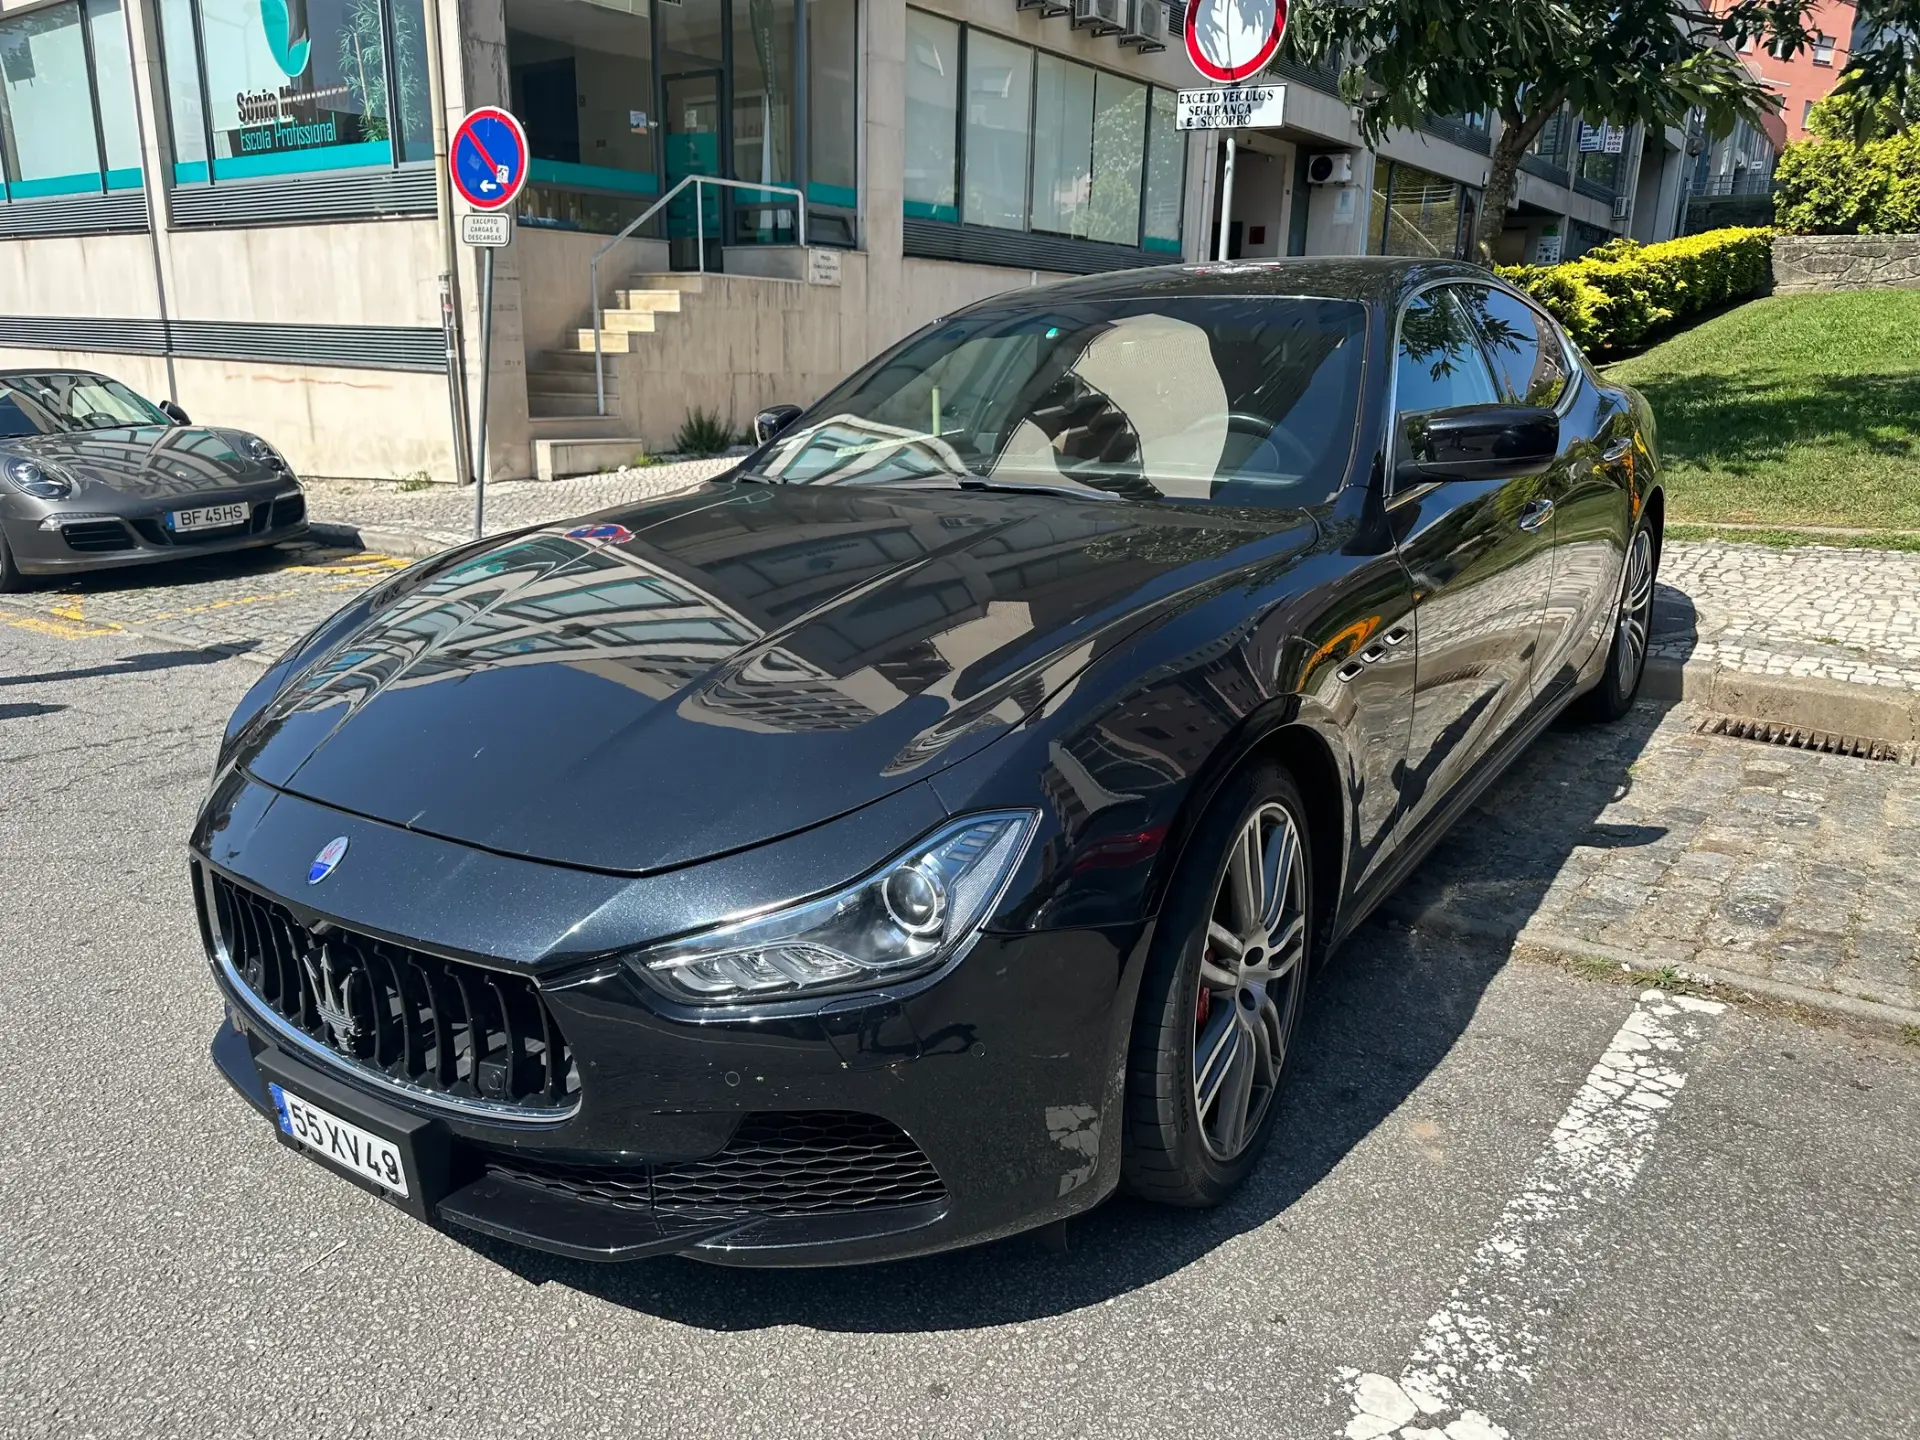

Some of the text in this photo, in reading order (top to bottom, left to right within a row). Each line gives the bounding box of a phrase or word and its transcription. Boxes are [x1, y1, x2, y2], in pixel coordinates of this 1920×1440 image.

[236, 88, 278, 122] Sónia
[1179, 92, 1219, 104] EXCETO
[239, 111, 337, 151] Escola Profissional
[1186, 114, 1252, 127] E SOCORRO
